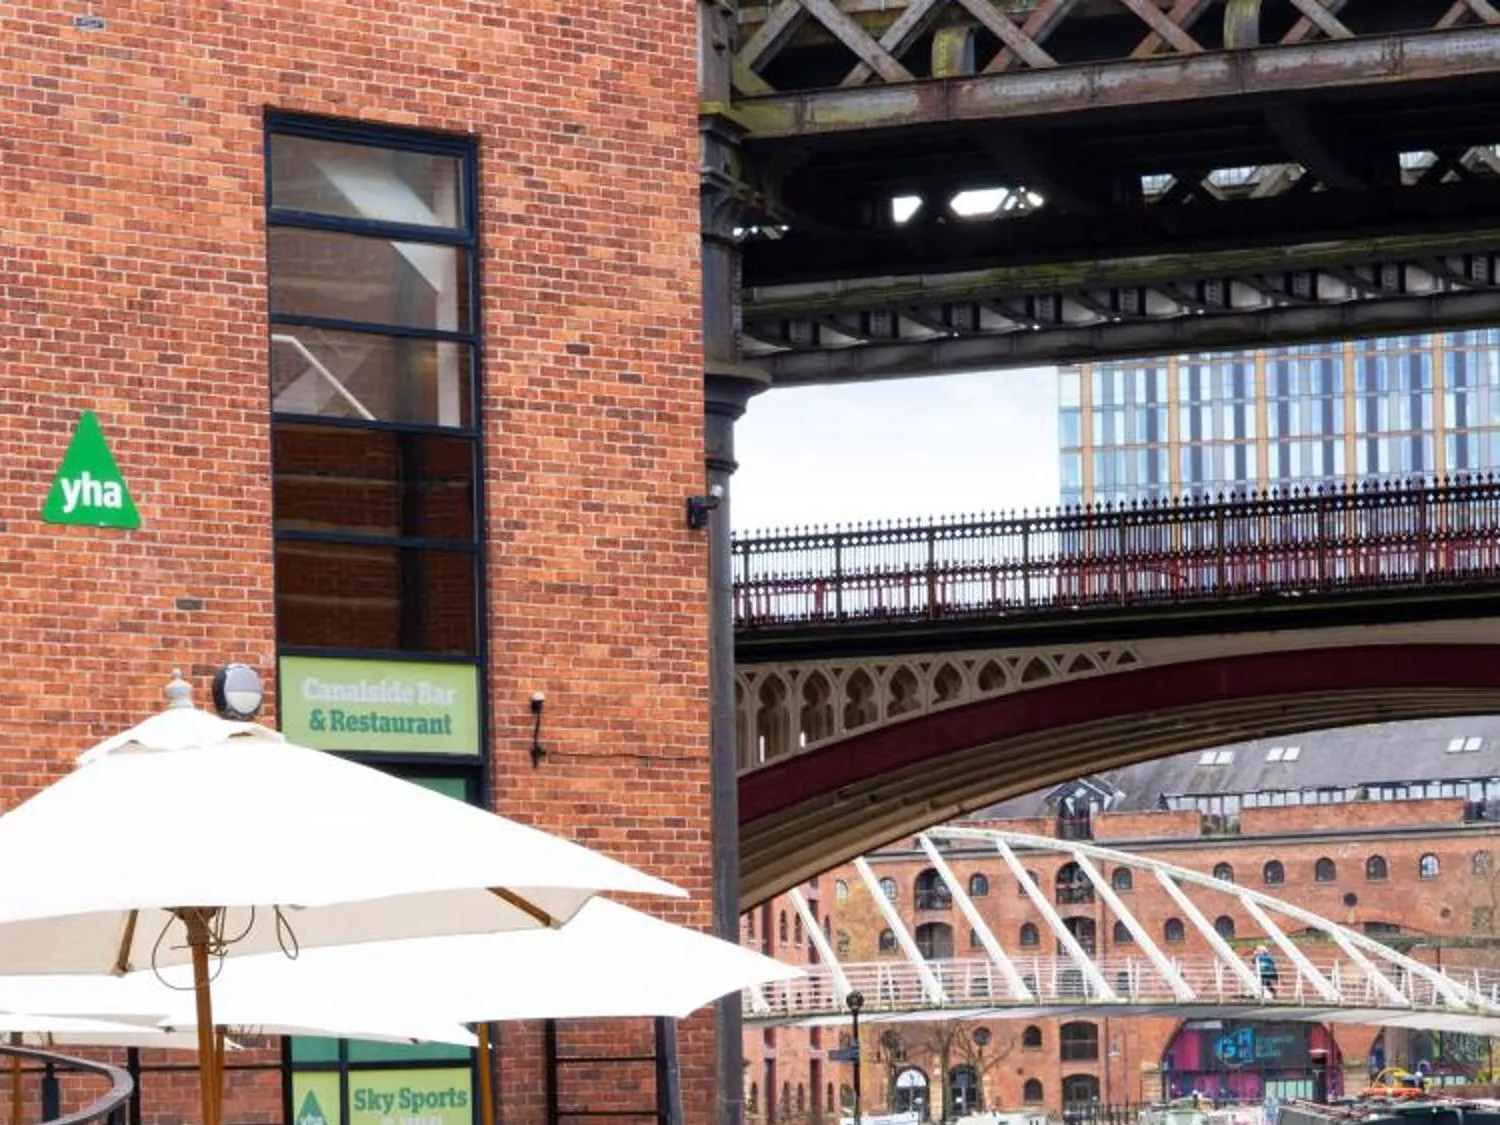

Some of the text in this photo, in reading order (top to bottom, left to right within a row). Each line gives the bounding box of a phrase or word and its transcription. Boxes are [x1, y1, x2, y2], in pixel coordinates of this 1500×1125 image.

[60, 471, 122, 513] yha
[304, 678, 456, 705] Canalside Bar
[309, 708, 453, 735] & Restaurant
[355, 1087, 468, 1115] Sky Sports
